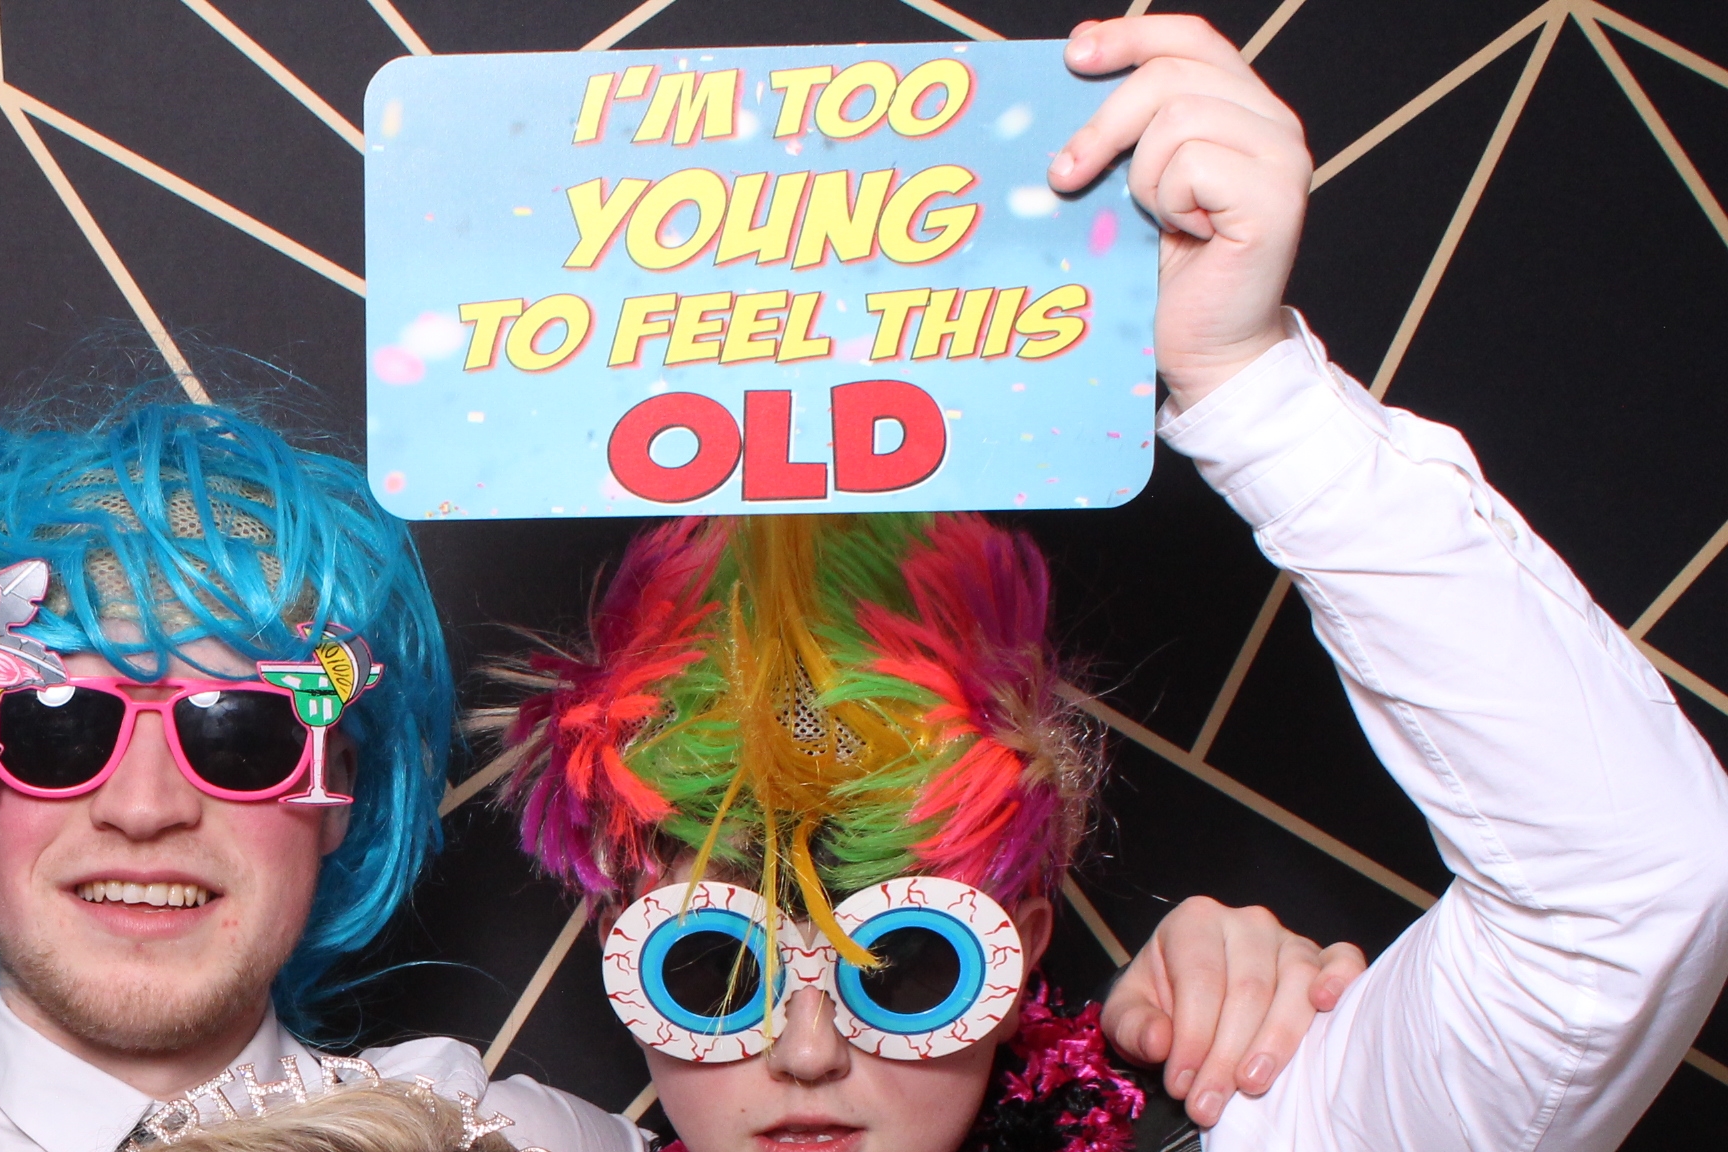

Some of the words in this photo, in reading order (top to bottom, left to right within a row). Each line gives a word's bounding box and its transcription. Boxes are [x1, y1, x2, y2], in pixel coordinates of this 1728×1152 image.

[572, 64, 744, 147] I'M
[769, 57, 974, 142] TOO
[562, 164, 982, 272] YOUNG
[459, 292, 595, 373] TO
[607, 289, 834, 368] FEEL
[865, 282, 1092, 362] THIS
[607, 379, 950, 505] OLD
